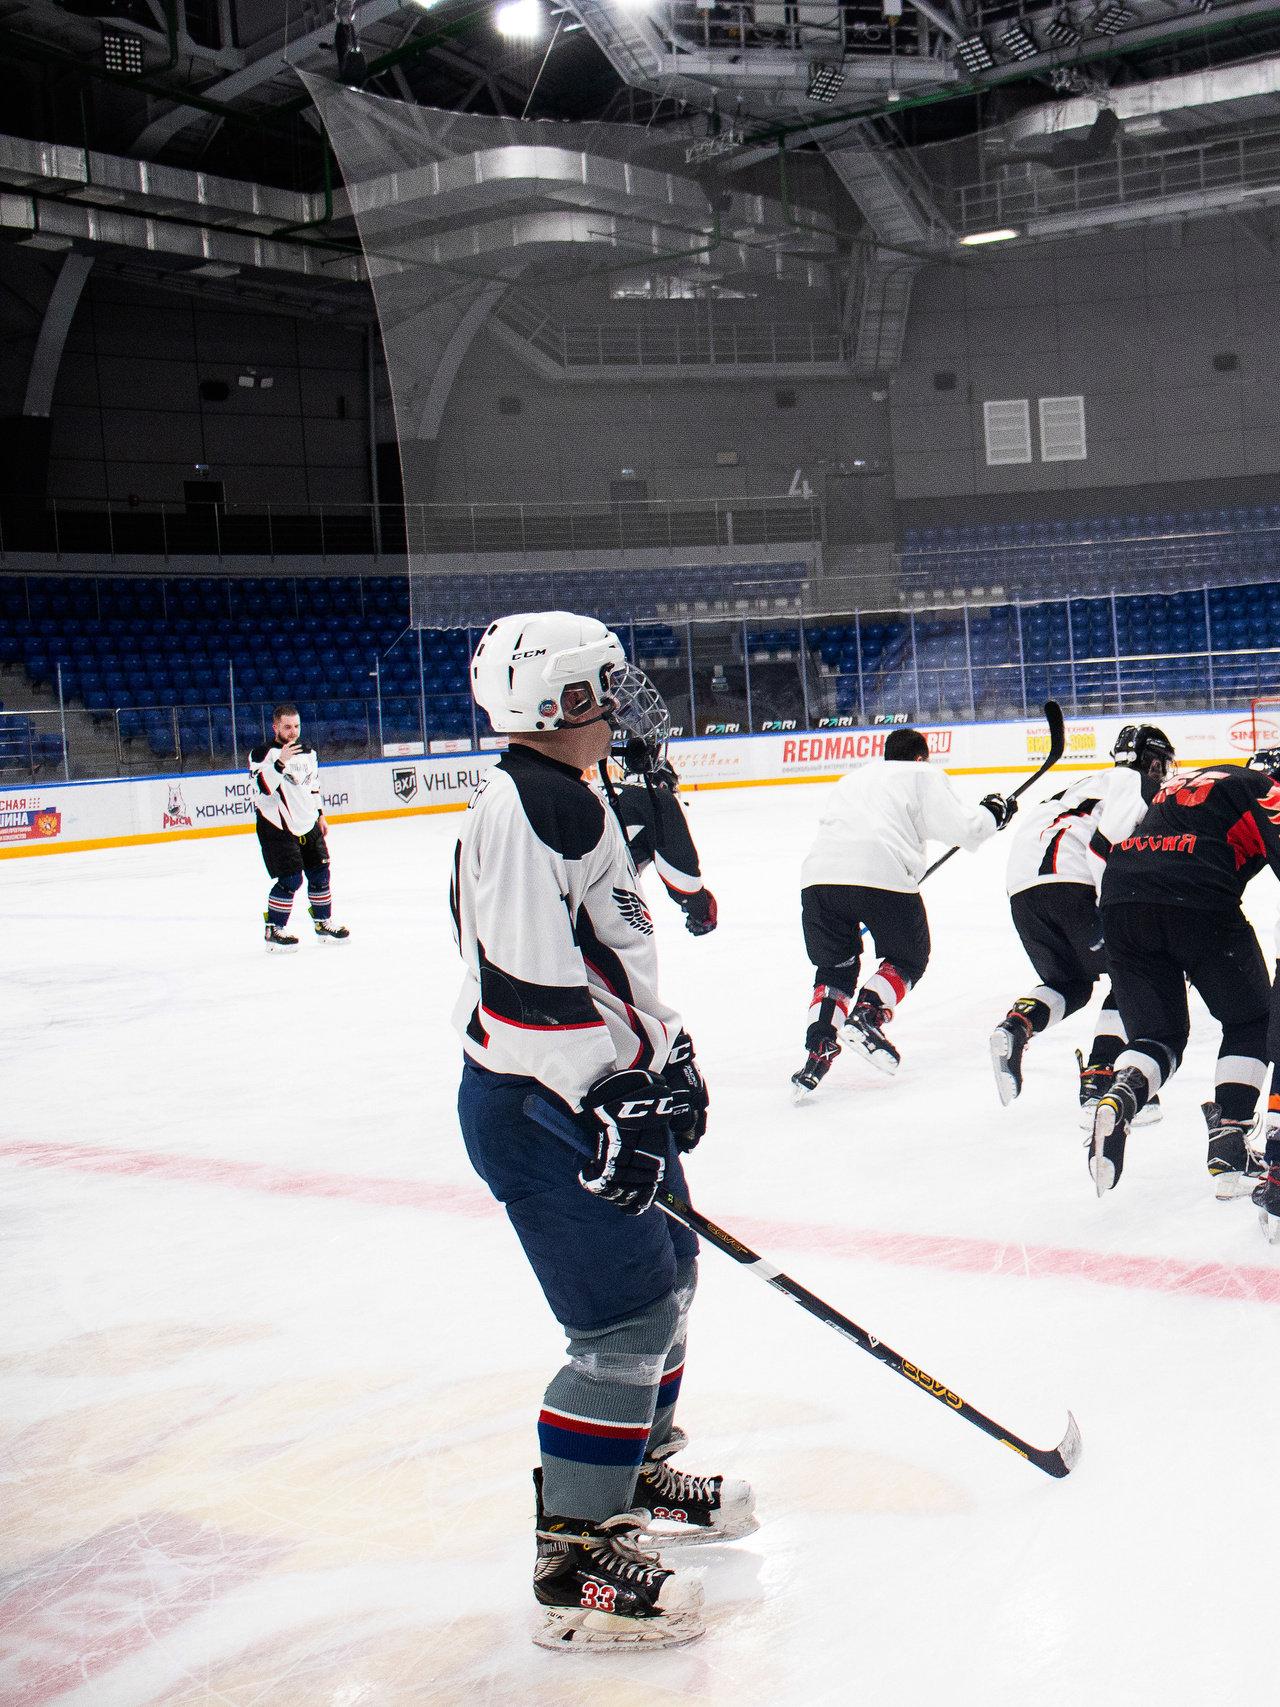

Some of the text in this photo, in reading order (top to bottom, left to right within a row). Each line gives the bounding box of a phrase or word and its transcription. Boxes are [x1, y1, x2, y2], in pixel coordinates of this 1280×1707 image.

[788, 469, 813, 499] 4
[511, 649, 547, 661] CCM
[818, 716, 853, 728] PARI
[874, 713, 909, 725] PARI
[705, 723, 740, 735] PARI
[761, 719, 796, 732] PARI
[1065, 726, 1095, 734] ЕХНИКА
[1231, 730, 1279, 741] SINTEC
[669, 752, 717, 761] НЕРГИЯ
[395, 775, 416, 794] ВХЛ
[163, 812, 192, 829] РЫСИ
[1110, 833, 1197, 854] ОССИЯ
[581, 1581, 617, 1613] 33
